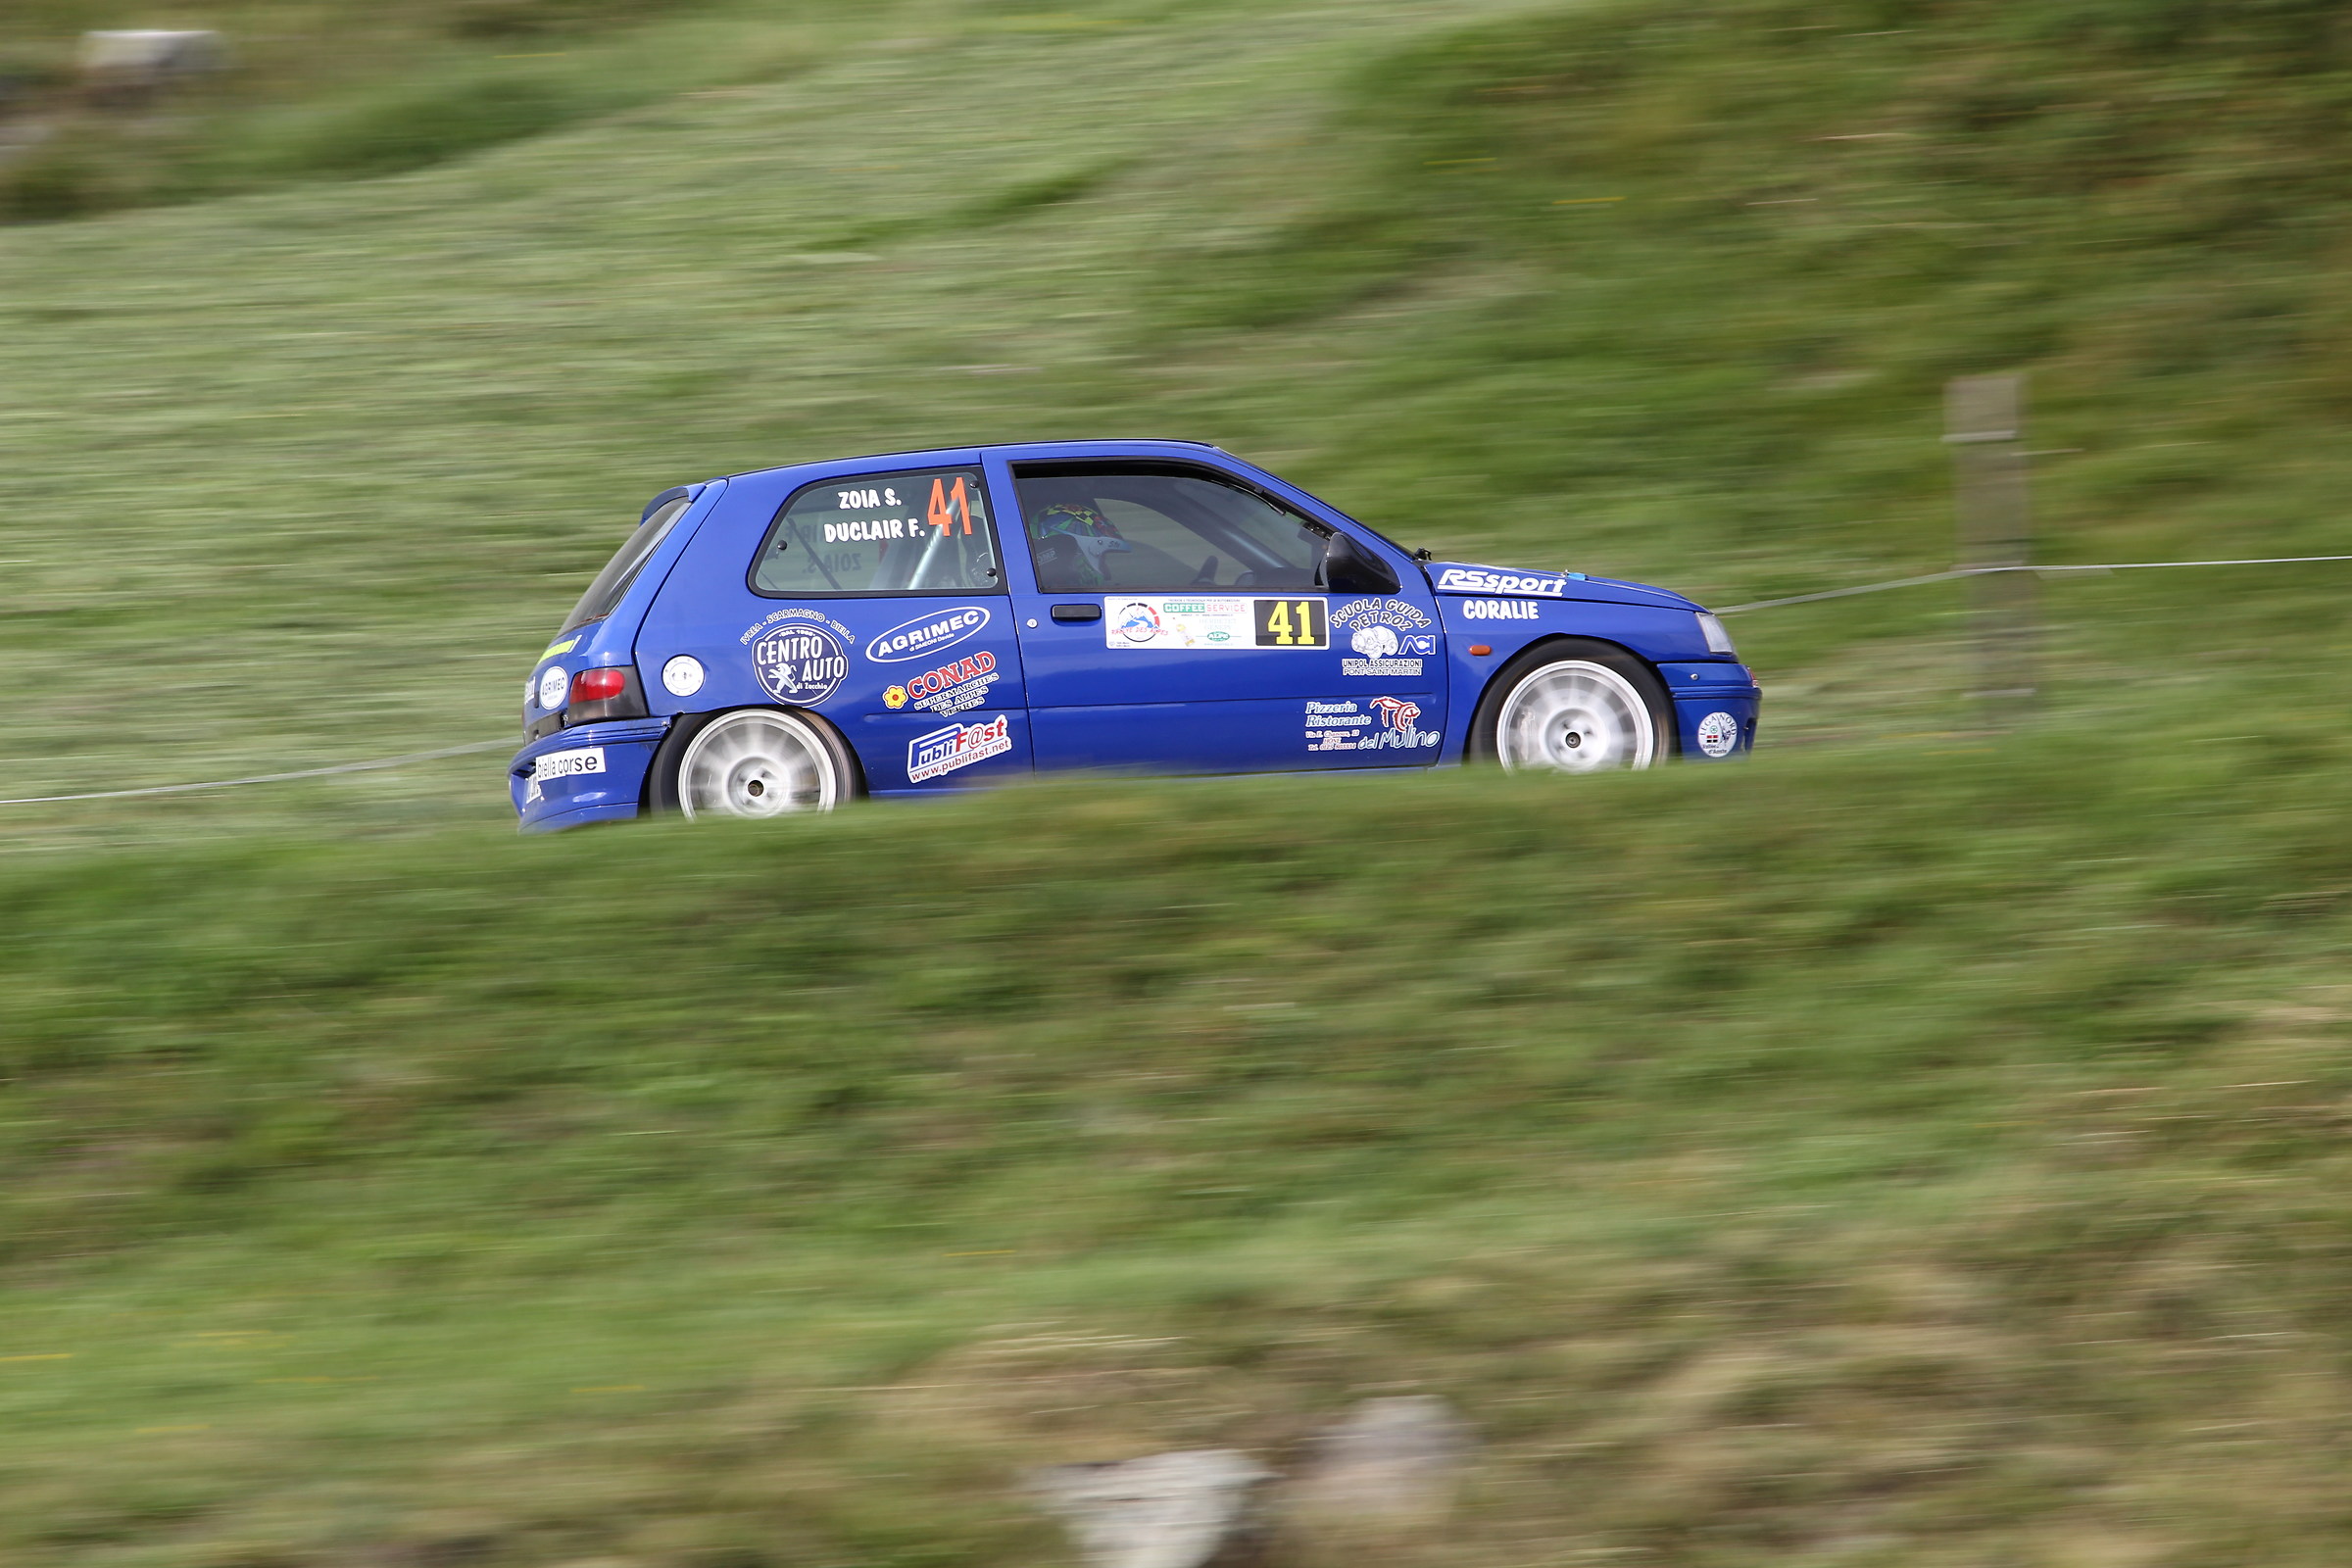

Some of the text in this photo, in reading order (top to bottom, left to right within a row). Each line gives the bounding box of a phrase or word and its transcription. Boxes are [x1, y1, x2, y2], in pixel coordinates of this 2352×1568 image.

[837, 488, 902, 510] ZOIA S.
[927, 476, 972, 537] 41
[824, 518, 904, 543] DUCLAIR
[908, 518, 926, 537] F.
[1438, 568, 1567, 596] RSsport
[1164, 604, 1246, 612] COFFEE SERVICE
[1330, 598, 1431, 628] SCUOLA GUIDA
[1463, 600, 1540, 619] CORALIE
[740, 622, 763, 645] IVREA
[766, 609, 825, 624] SCARMAGNO
[830, 619, 856, 645] BIELLA
[878, 610, 980, 658] AGRIMEC
[1267, 601, 1315, 645] 41
[1349, 611, 1413, 632] PETROZ
[757, 636, 823, 665] CENTRO
[1342, 659, 1422, 667] UNIPOL ASSICURAZIONI
[802, 656, 845, 682] AUTO
[907, 652, 996, 699] CONAD
[914, 673, 999, 710] SUPERMARCHES
[930, 686, 989, 713] DES ALPES
[940, 696, 985, 717] VERRES
[1305, 701, 1357, 713] Pizzeria
[1305, 714, 1372, 727] Ristorante
[1700, 713, 1736, 735] LEGA NORD
[1358, 725, 1440, 750] del Mulino
[558, 755, 598, 774] corse
[911, 739, 1009, 781] www.publifast.net
